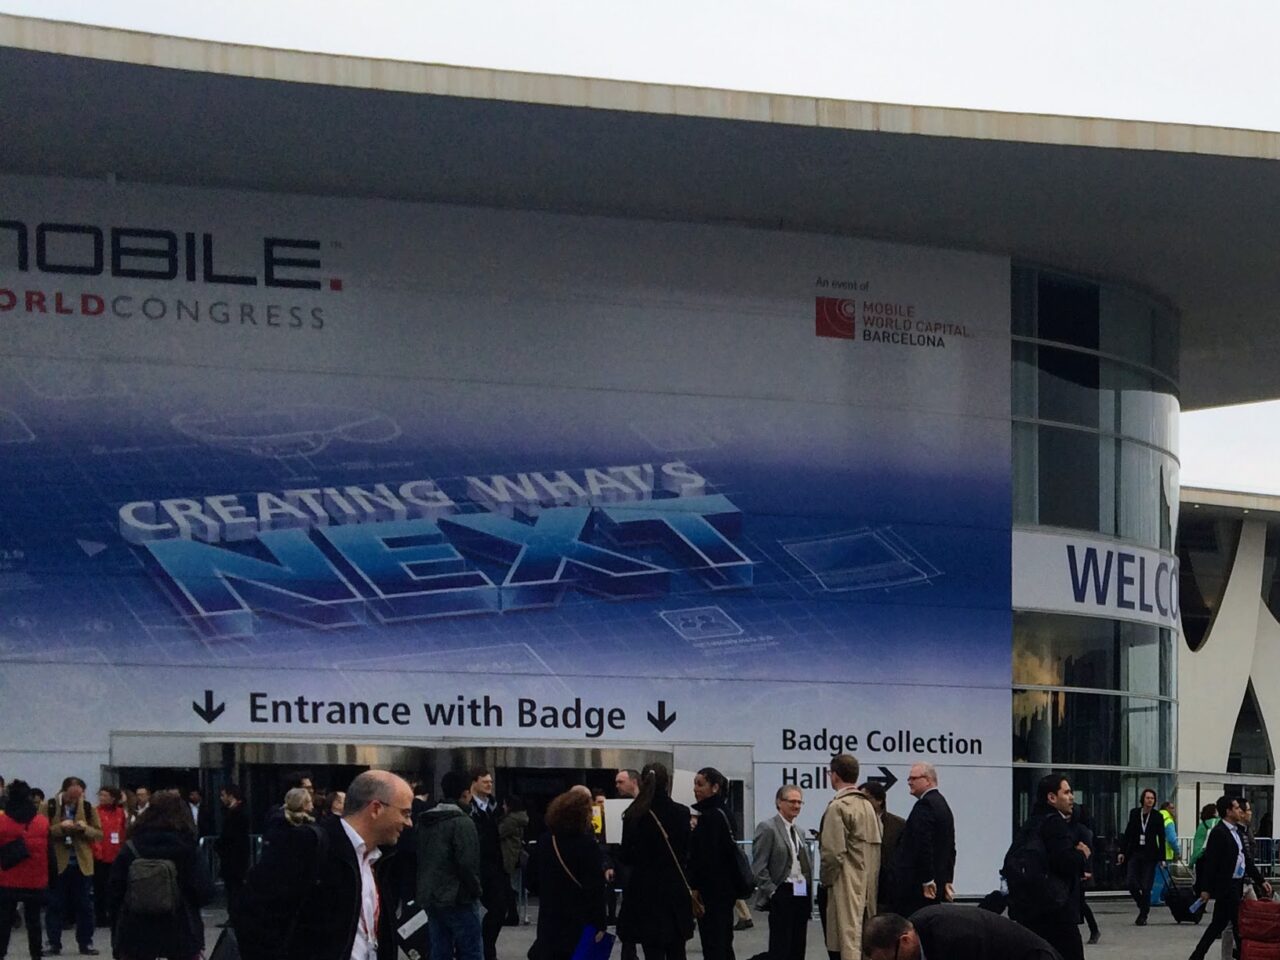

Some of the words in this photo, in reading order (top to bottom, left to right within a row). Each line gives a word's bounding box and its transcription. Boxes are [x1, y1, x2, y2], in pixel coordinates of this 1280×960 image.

[816, 276, 829, 288] An
[832, 279, 858, 291] event
[860, 281, 869, 292] of
[863, 301, 915, 318] MOBILE
[863, 316, 912, 331] WORLD
[916, 320, 969, 338] CAPITAL
[863, 329, 946, 348] BARCELONA
[119, 478, 456, 546] CREATING
[466, 460, 713, 519] WHAT'S
[143, 493, 754, 645] NEXT
[249, 692, 412, 727] Entrance
[425, 696, 503, 728] with
[518, 697, 626, 738] Badge
[782, 728, 858, 757] Badge
[866, 729, 983, 755] Collection
[782, 767, 828, 790] Hall
